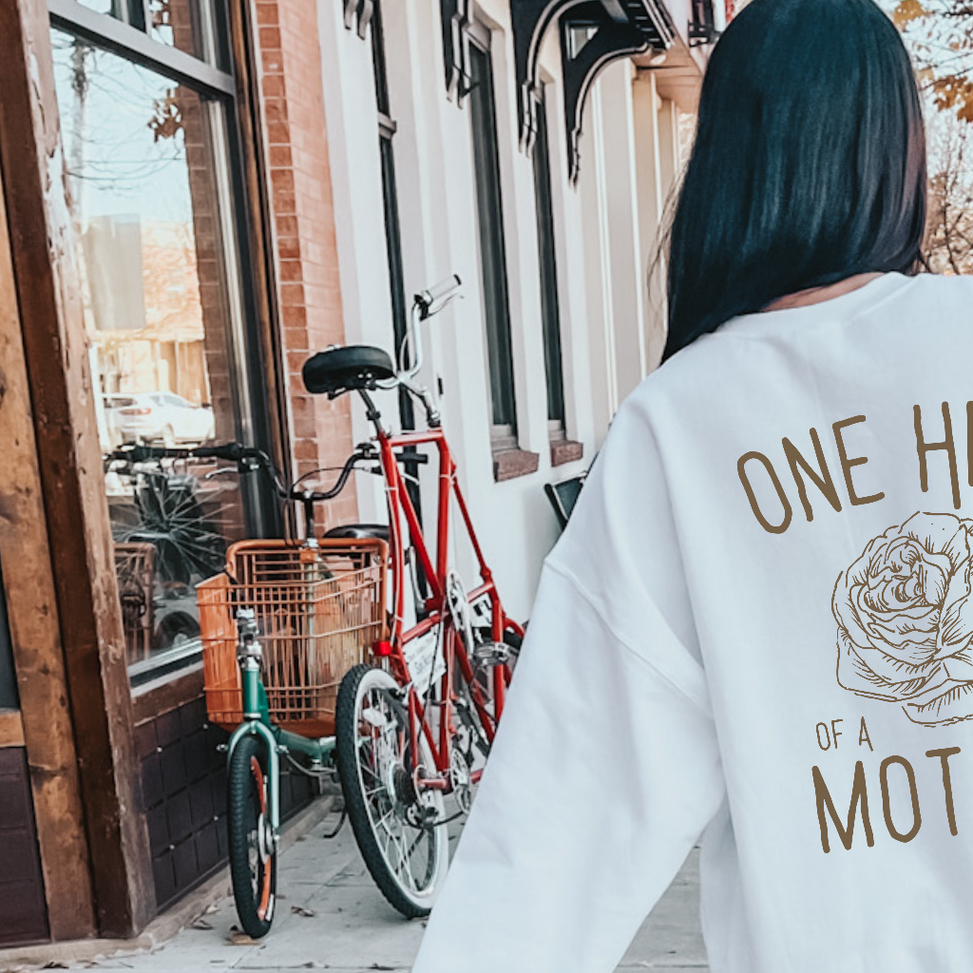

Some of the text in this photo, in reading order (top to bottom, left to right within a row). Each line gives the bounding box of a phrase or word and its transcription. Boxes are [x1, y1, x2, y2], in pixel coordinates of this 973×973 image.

[737, 415, 886, 534] ONE
[816, 716, 873, 752] OF A
